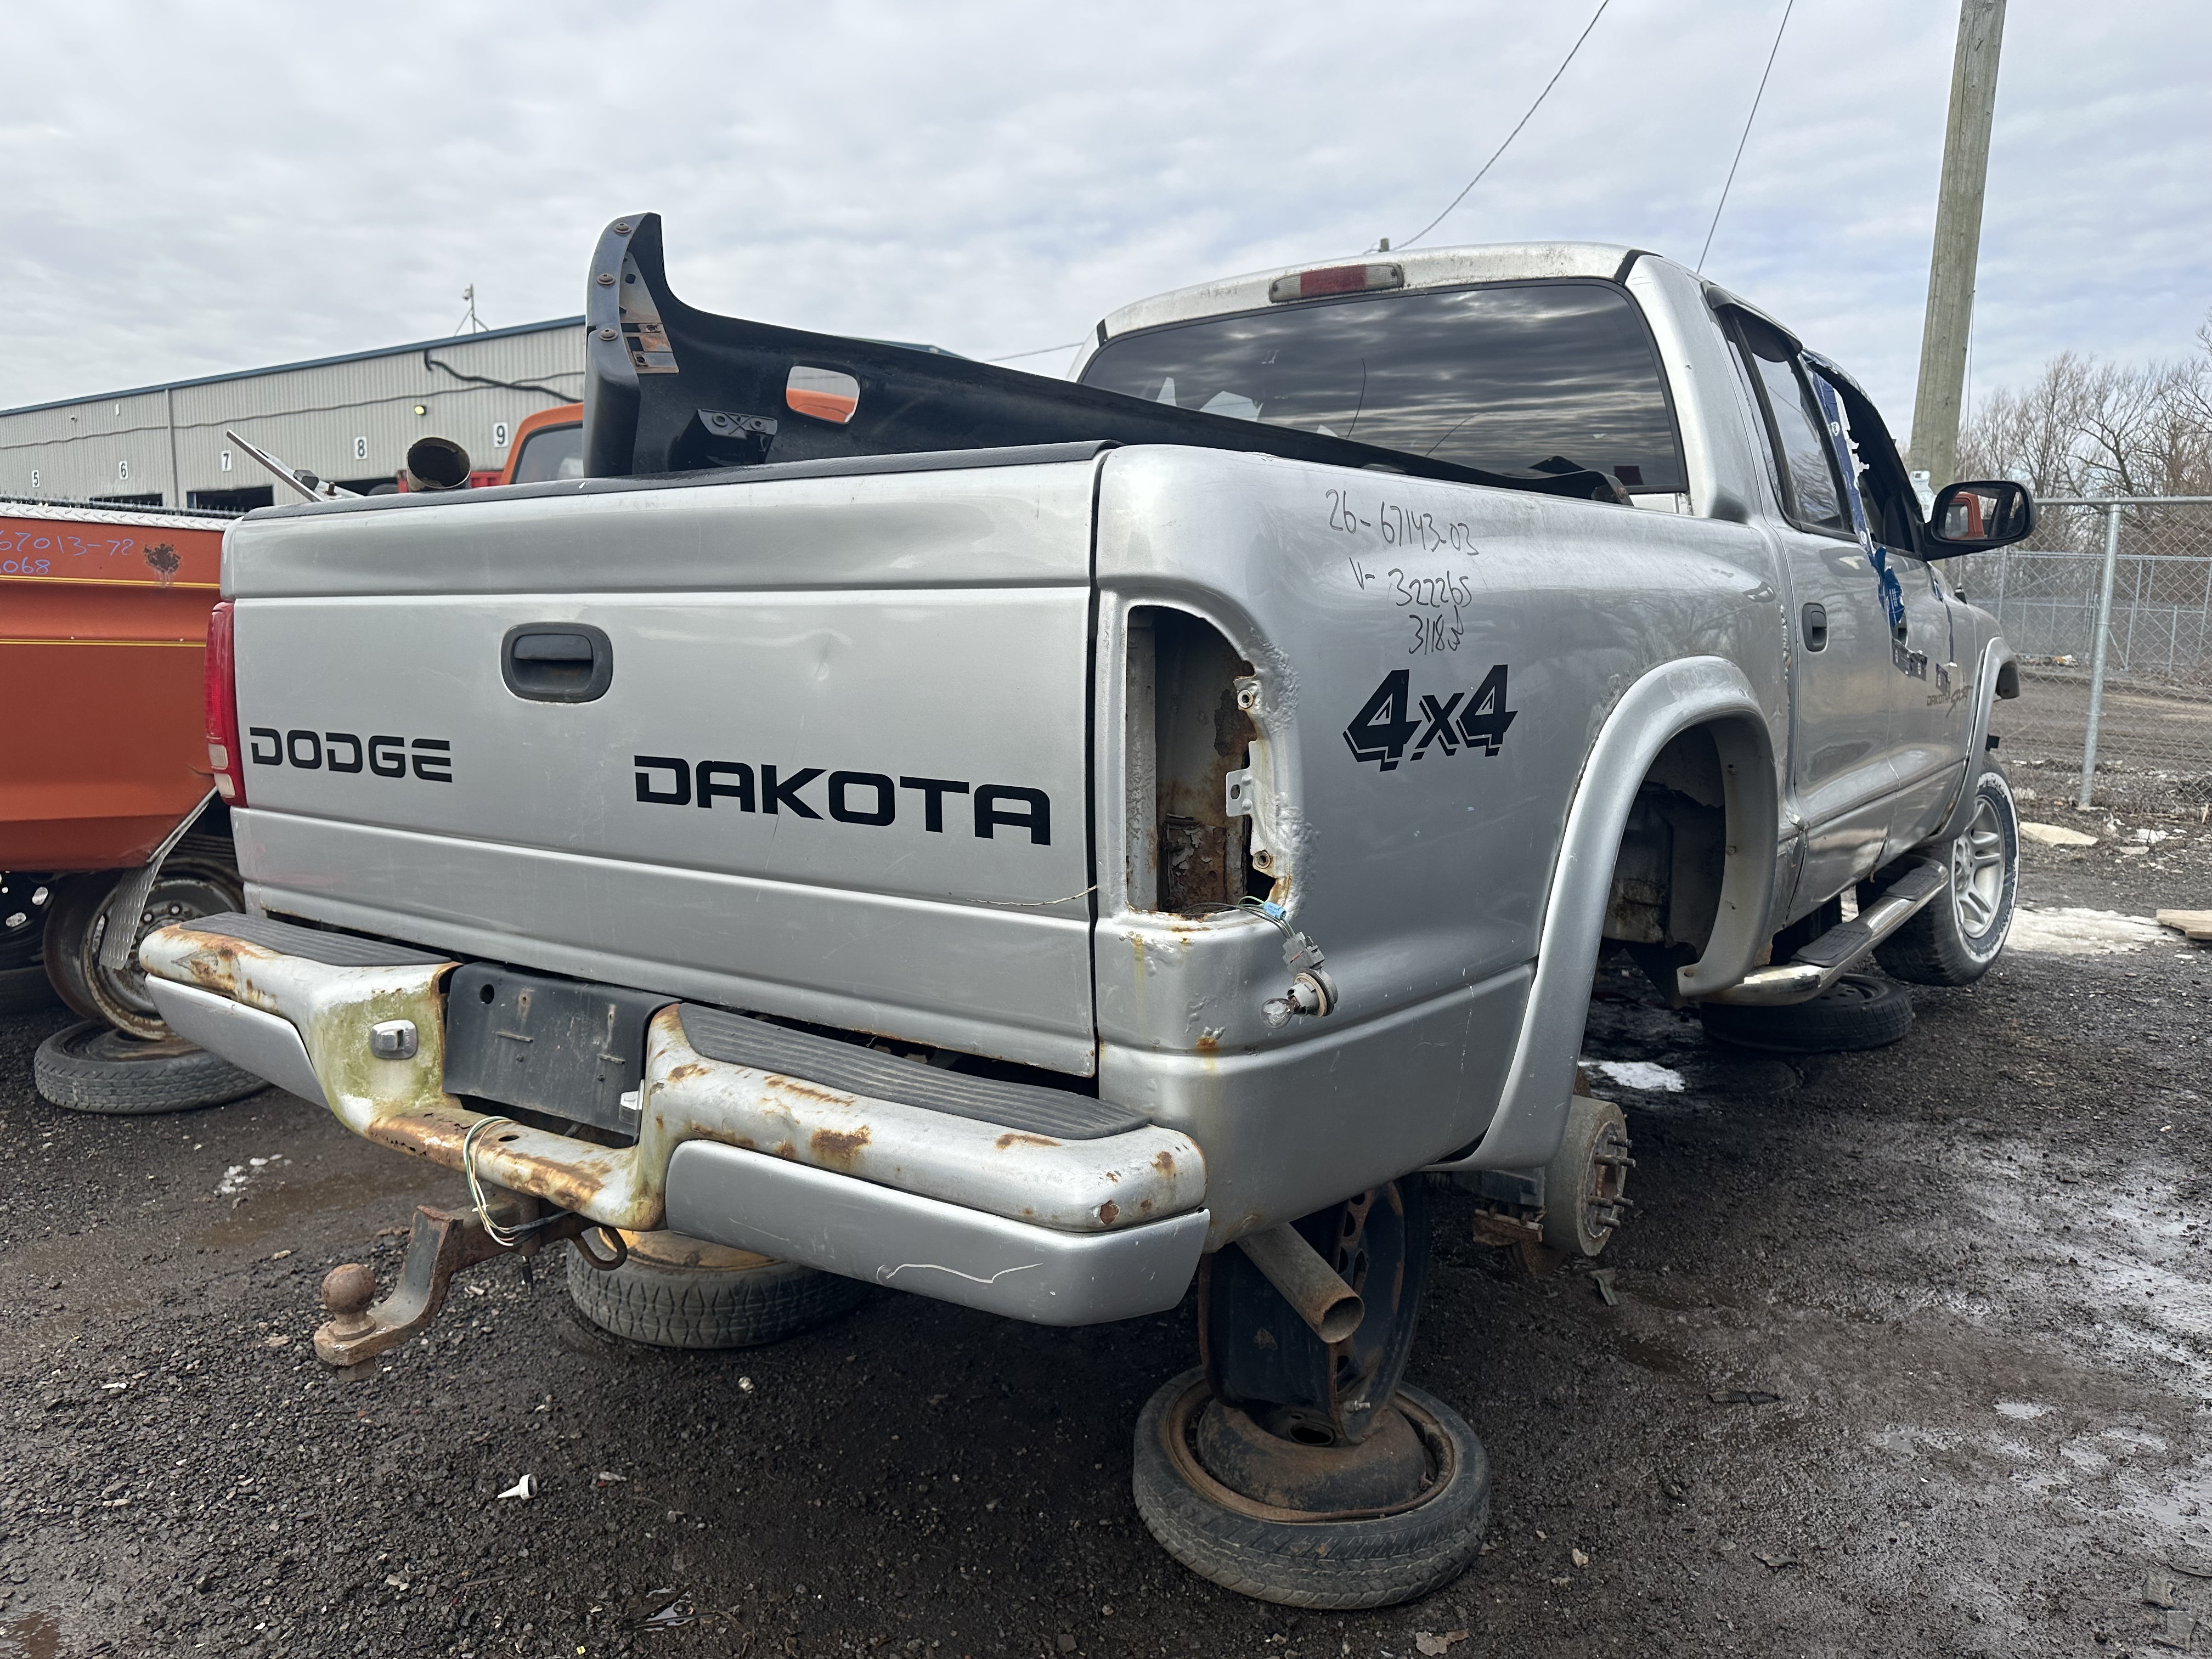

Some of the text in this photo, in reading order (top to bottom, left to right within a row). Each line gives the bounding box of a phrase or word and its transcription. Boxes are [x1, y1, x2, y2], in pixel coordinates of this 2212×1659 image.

[496, 426, 505, 444] 9
[358, 439, 364, 456] 8
[121, 463, 126, 477] 6
[223, 453, 229, 469] 7
[33, 472, 38, 486] 5
[0, 556, 50, 574] 068
[1342, 664, 1518, 772] 4x4
[250, 727, 453, 783] DODGE
[634, 755, 1051, 846] DAKOTA
